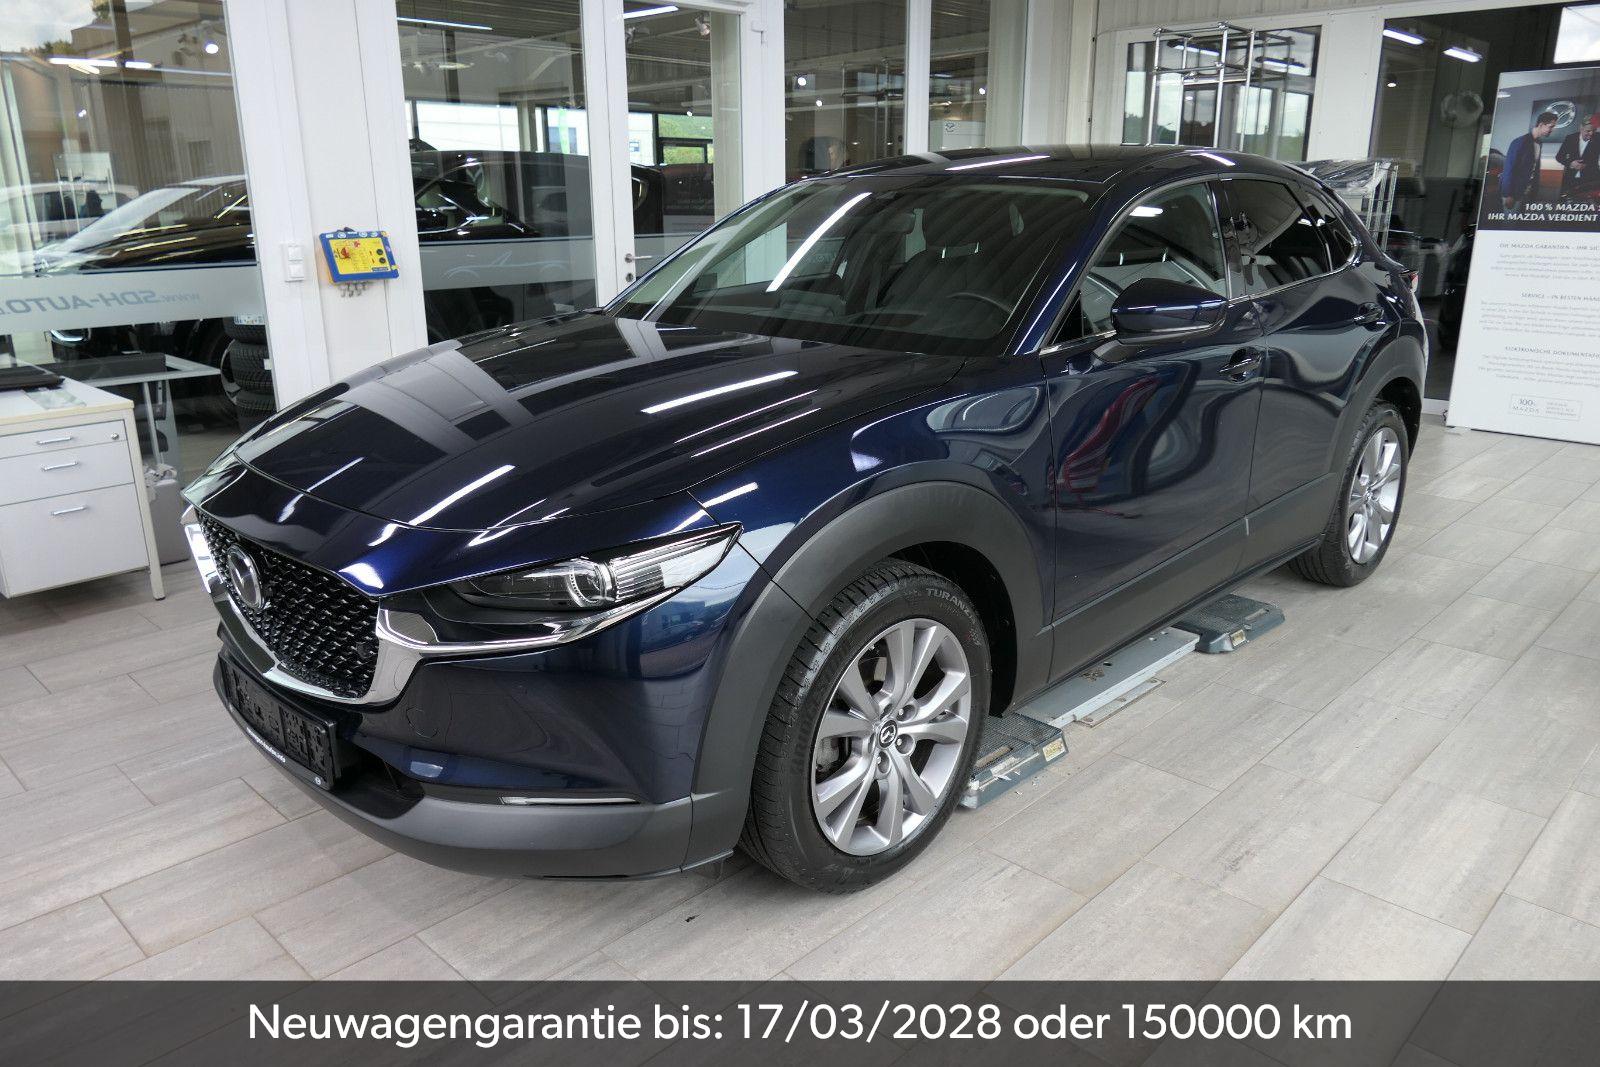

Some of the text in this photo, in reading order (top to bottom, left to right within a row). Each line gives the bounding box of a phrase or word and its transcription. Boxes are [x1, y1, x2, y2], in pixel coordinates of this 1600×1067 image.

[1525, 203, 1543, 211] 100
[1555, 203, 1596, 212] MAZDA
[1487, 212, 1598, 222] IHR MAZDA VERDIENT
